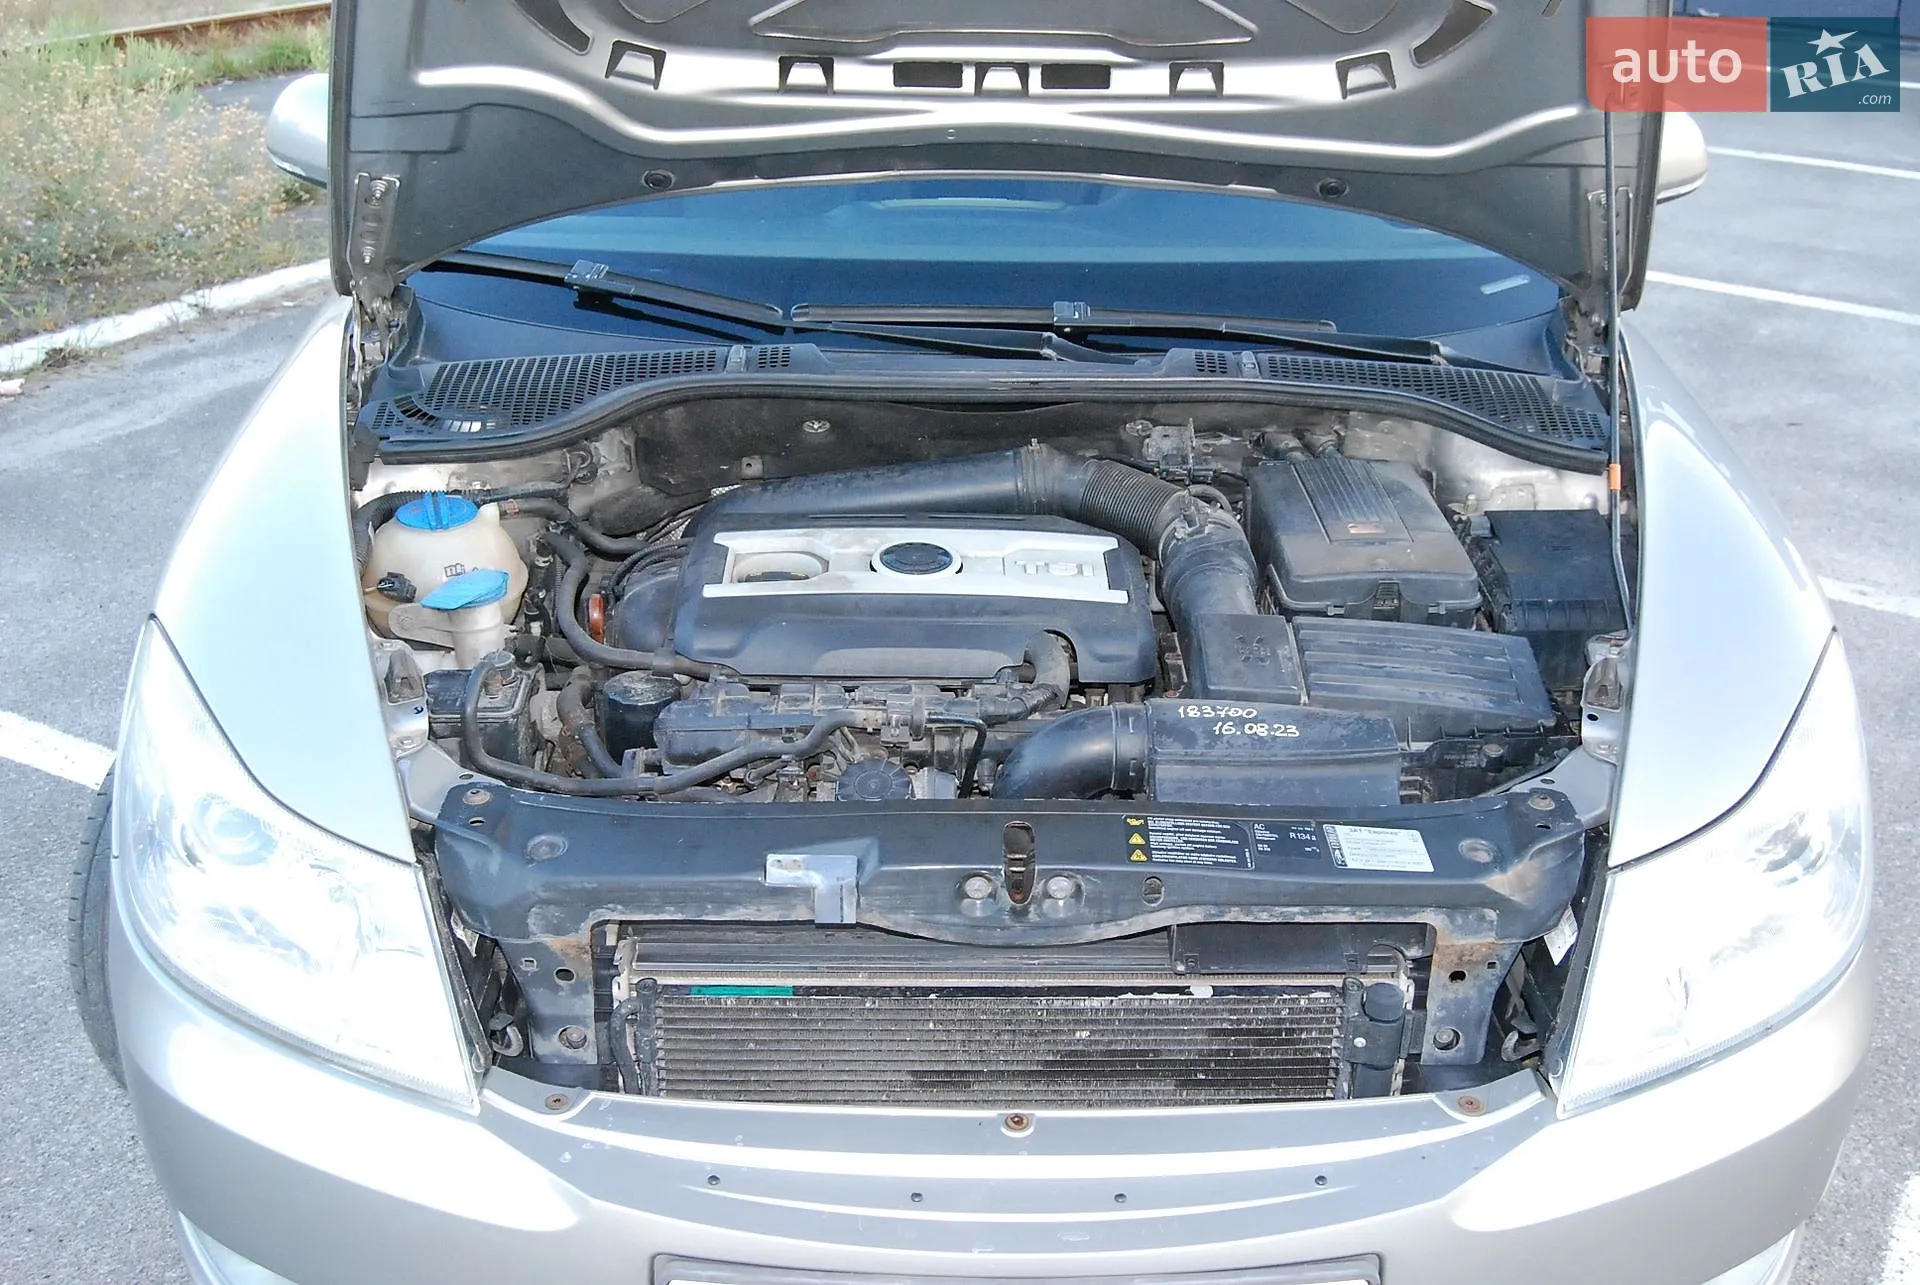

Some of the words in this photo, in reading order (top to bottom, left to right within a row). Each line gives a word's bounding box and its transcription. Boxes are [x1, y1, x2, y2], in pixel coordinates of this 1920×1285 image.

[1014, 560, 1095, 577] TSI
[1178, 705, 1258, 719] 183700
[1212, 721, 1300, 737] 16.08.23
